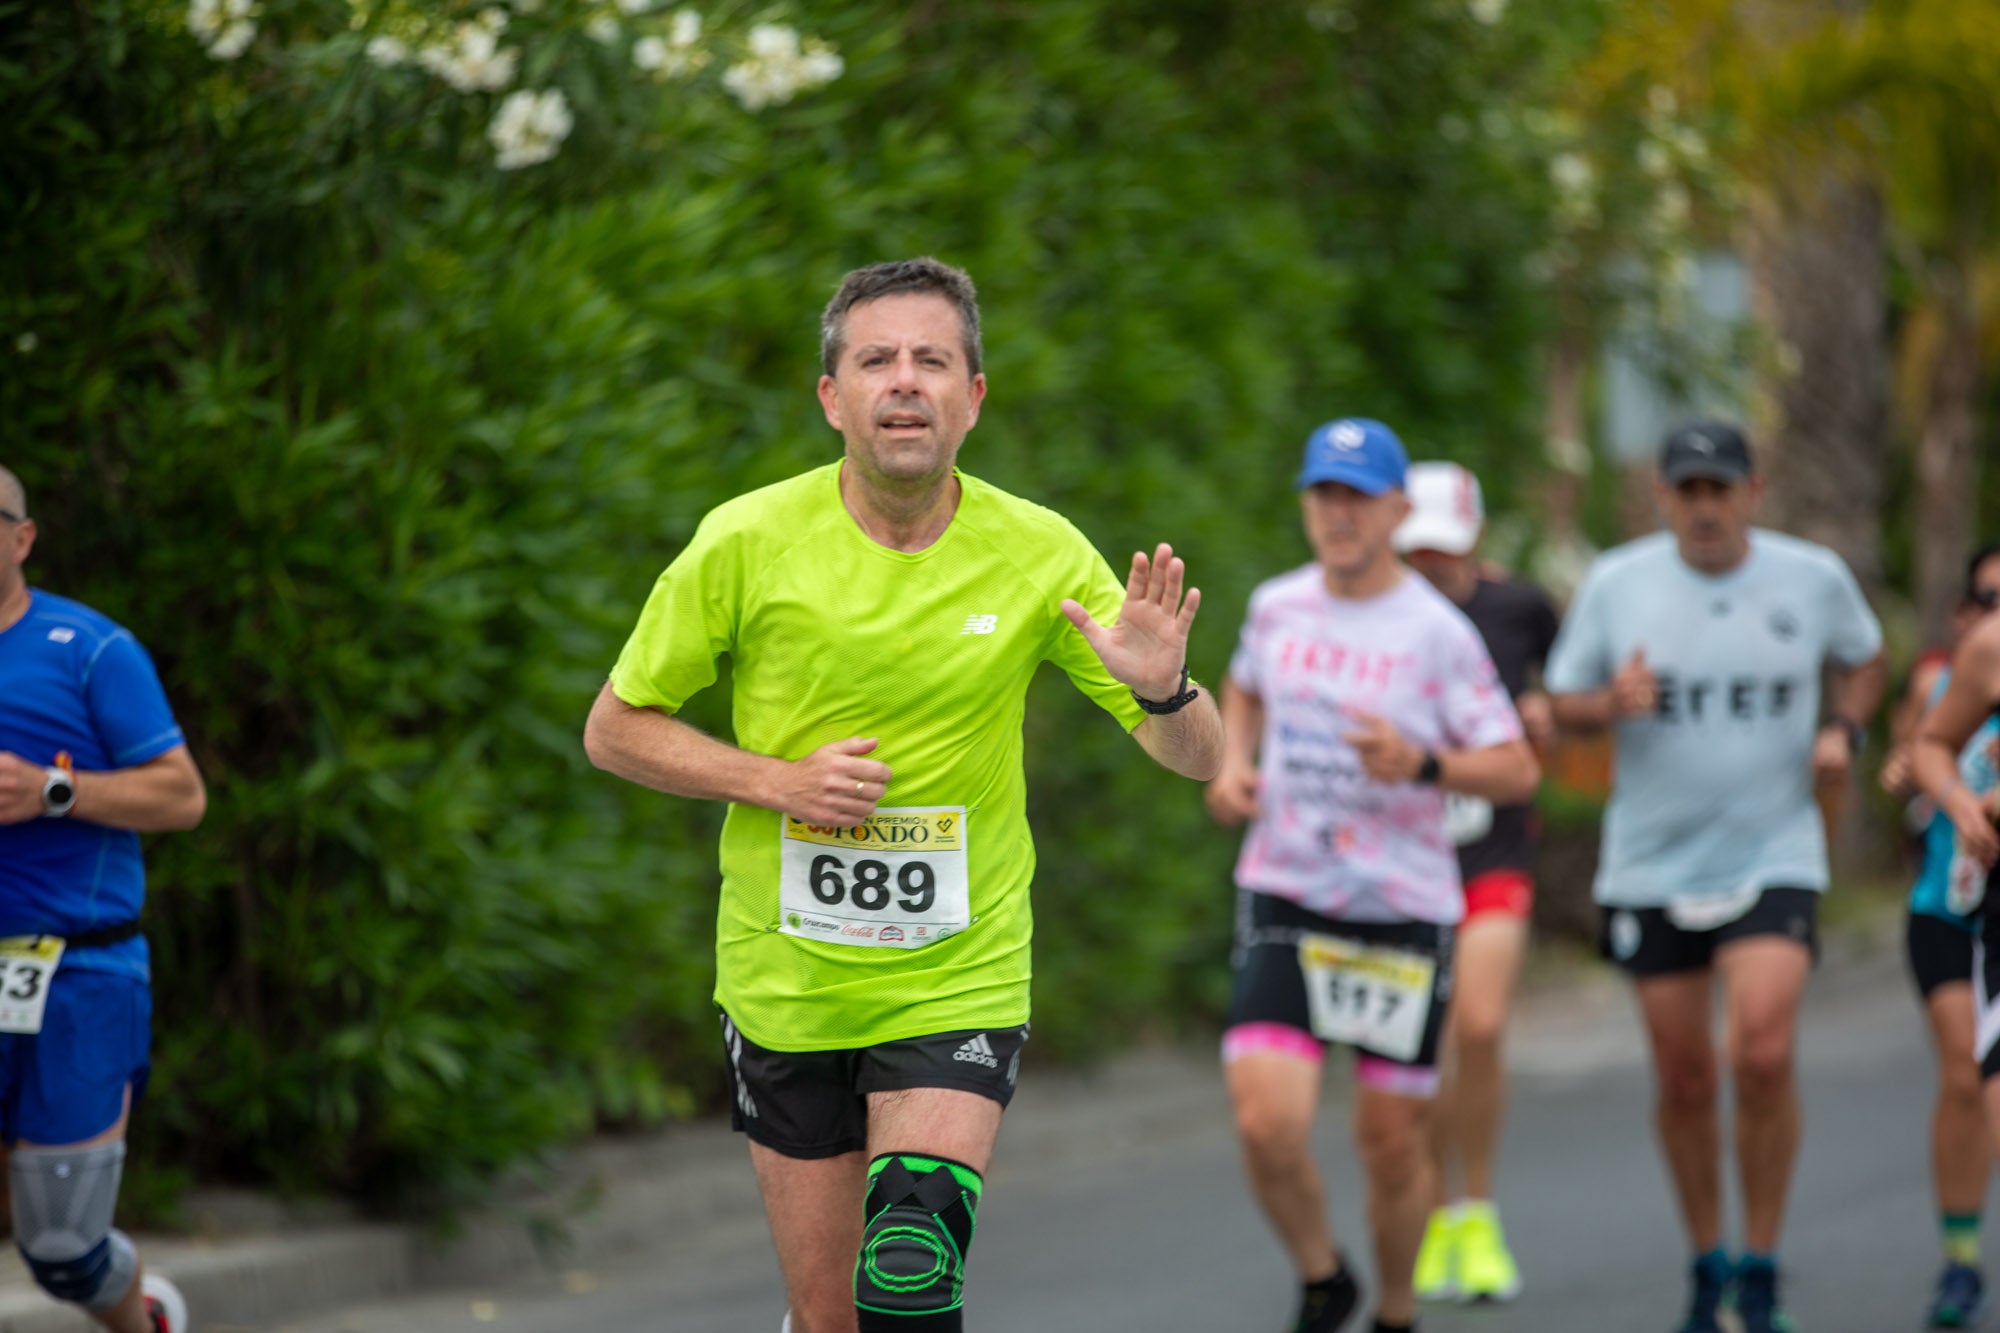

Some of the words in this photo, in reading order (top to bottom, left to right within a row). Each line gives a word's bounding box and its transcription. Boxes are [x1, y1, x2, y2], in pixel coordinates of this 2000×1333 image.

[877, 817, 921, 826] PREMIO
[810, 854, 935, 913] 689
[0, 960, 42, 1000] 3
[953, 1051, 998, 1069] adidas
